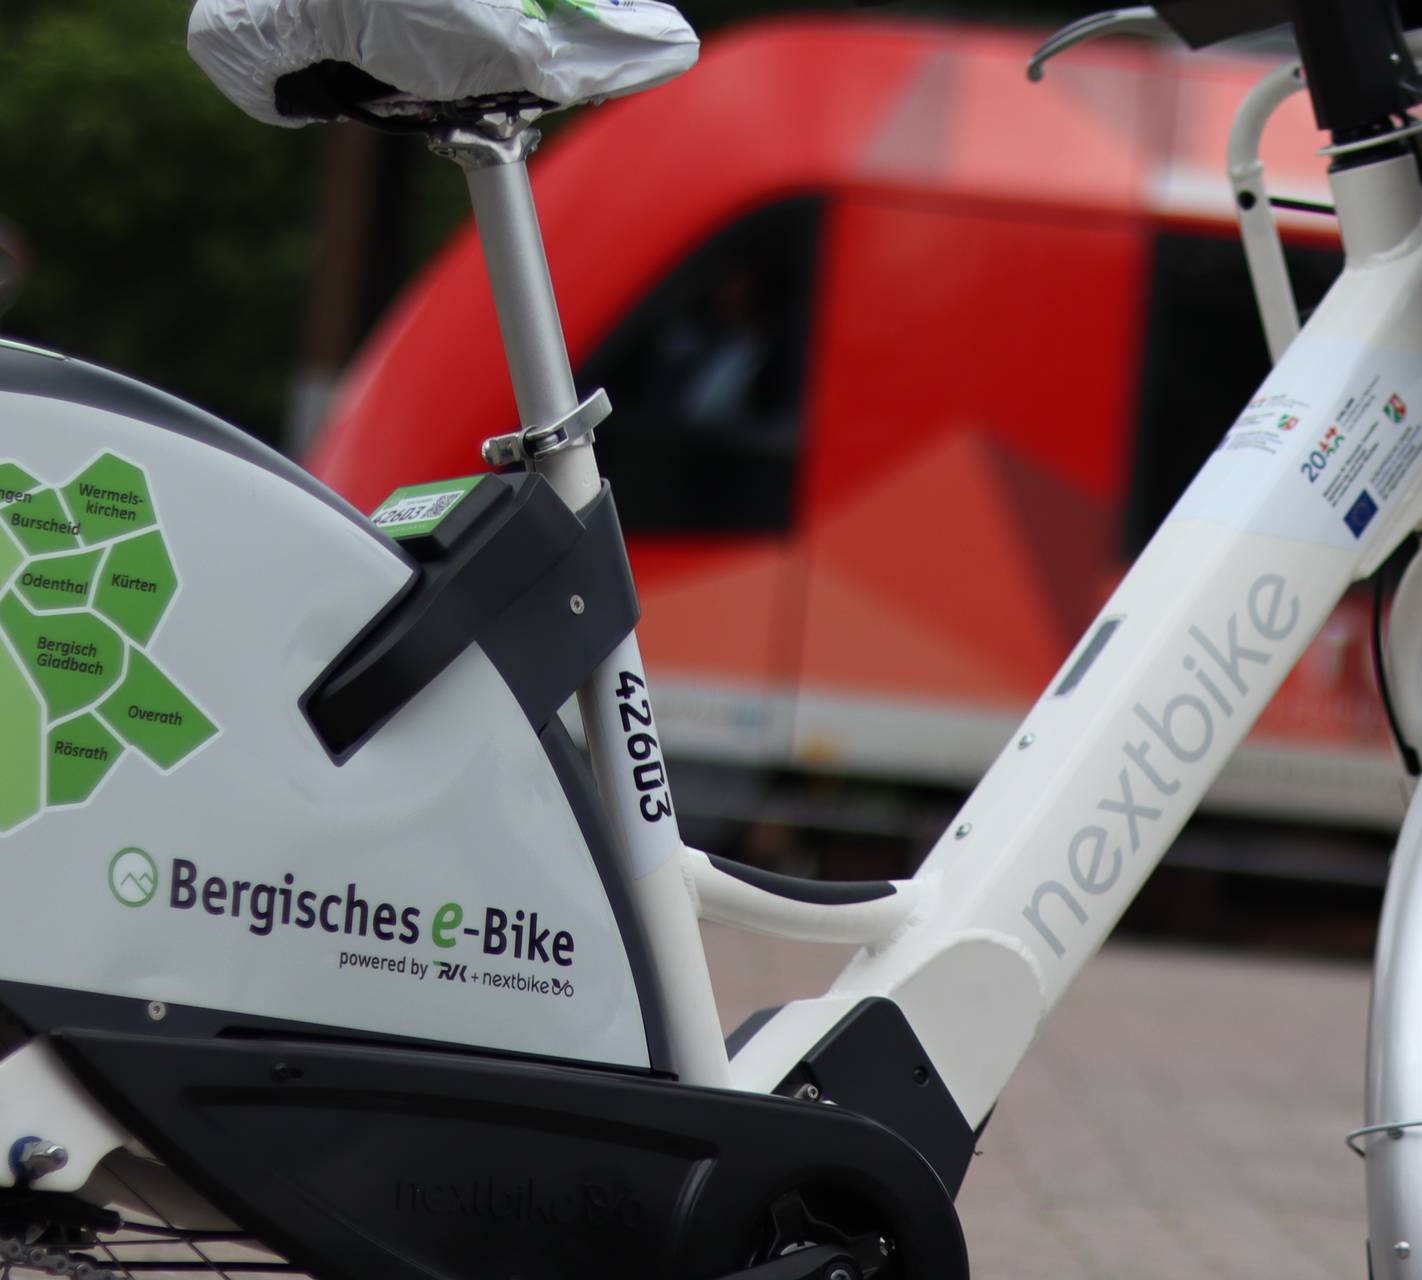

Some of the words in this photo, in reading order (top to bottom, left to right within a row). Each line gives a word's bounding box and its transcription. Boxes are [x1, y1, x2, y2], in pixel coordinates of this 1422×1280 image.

[79, 483, 143, 505] Wermels-
[86, 502, 136, 522] kirchen
[11, 513, 80, 536] Burscheid
[21, 573, 88, 595] Odenthal
[112, 574, 157, 594] Kürten
[37, 636, 97, 658] Bergisch
[37, 653, 104, 676] Gladbach
[128, 704, 183, 726] Overath
[54, 740, 108, 762] Rösrath
[616, 671, 672, 823] 42603
[1022, 573, 1299, 959] nextbike
[169, 858, 420, 945] Bergisches
[431, 901, 575, 966] e-Bike
[339, 951, 406, 973] powered
[411, 957, 428, 980] by
[482, 972, 550, 994] nextbike
